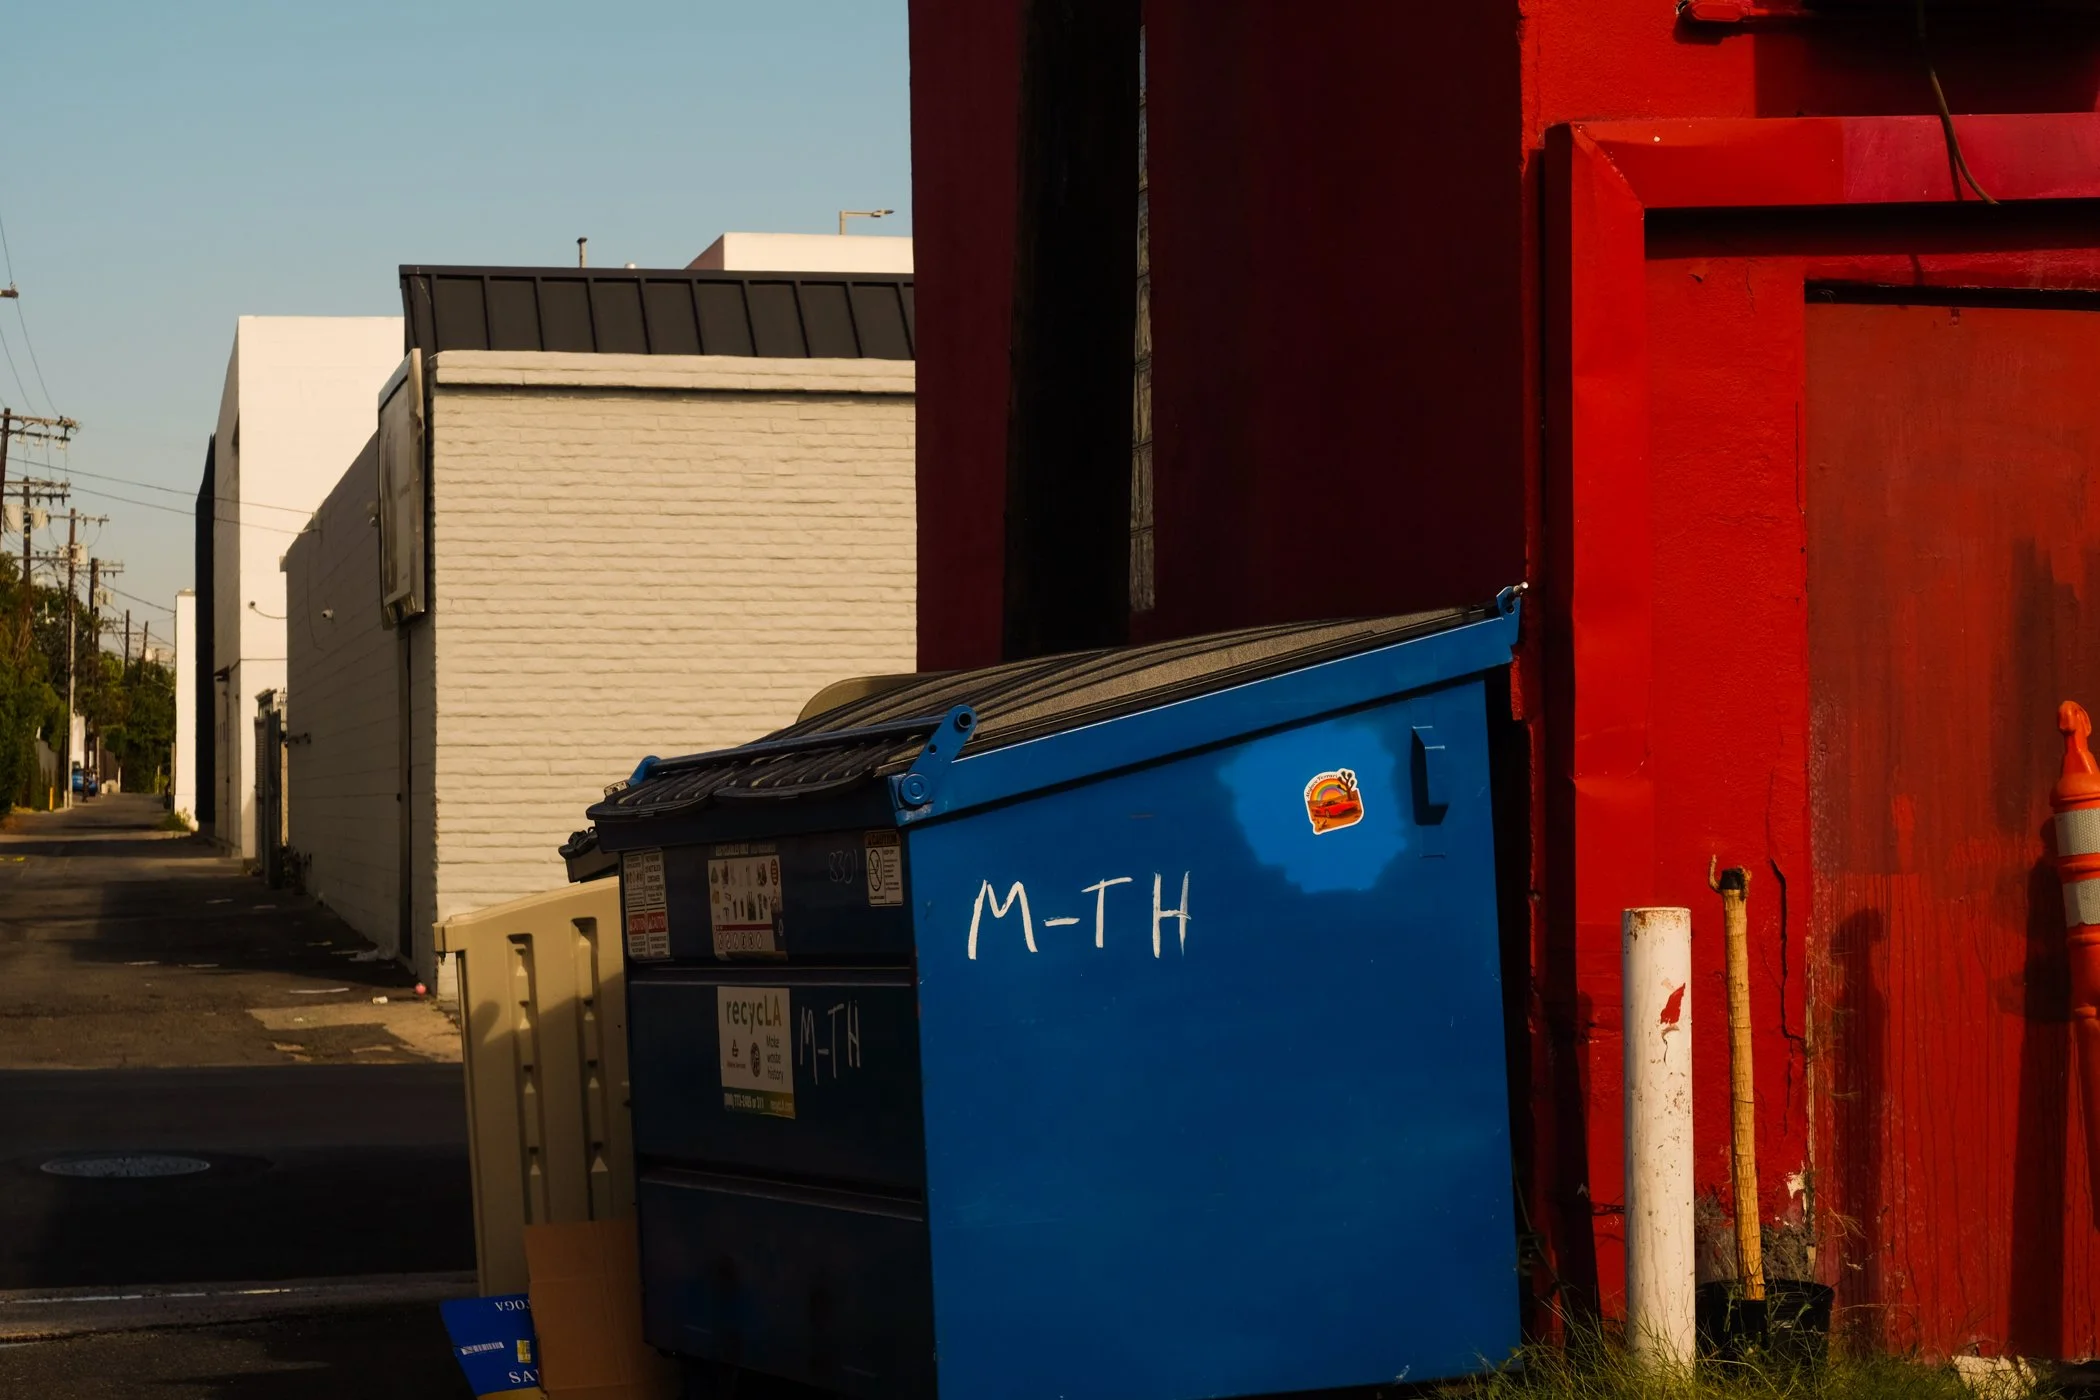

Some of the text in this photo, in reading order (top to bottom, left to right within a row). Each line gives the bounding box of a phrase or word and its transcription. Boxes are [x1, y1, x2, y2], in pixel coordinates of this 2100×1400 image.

[968, 871, 1192, 960] M-TH
[726, 994, 782, 1035] recycLA
[799, 1000, 861, 1086] M-TH
[494, 1299, 531, 1312] OGA
